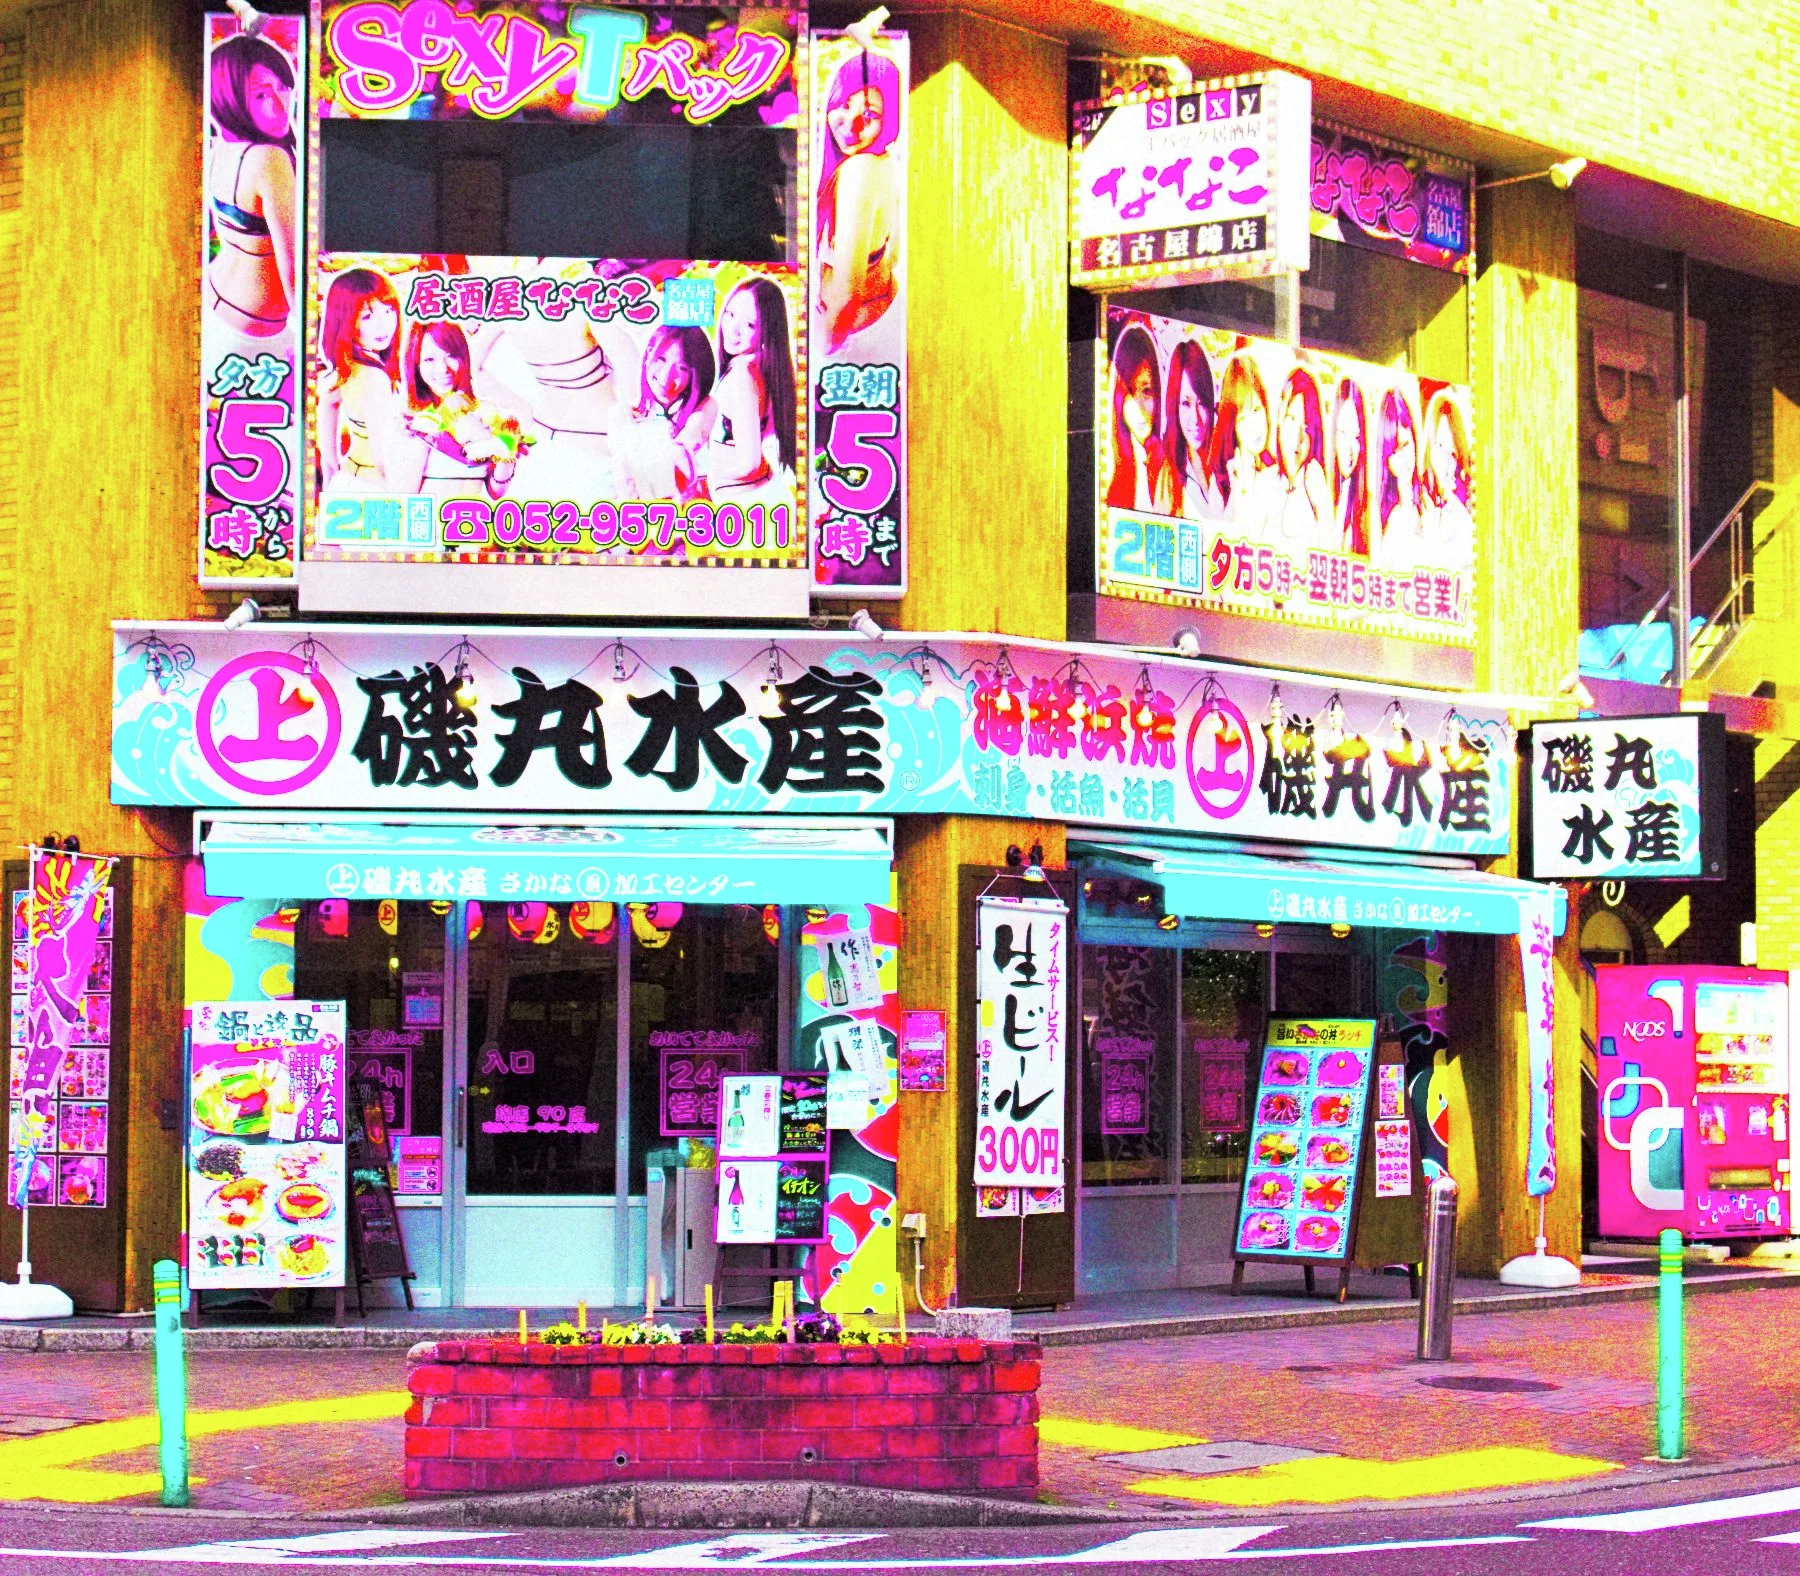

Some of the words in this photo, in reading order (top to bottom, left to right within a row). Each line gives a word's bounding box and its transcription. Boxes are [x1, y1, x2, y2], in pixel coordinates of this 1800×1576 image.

[333, 0, 577, 117] Sexy
[1149, 89, 1261, 128] Sexy
[1092, 147, 1268, 219] ななこ
[1097, 219, 1259, 266] 名古屋錦店
[411, 276, 657, 323] 居酒屋ななこ
[212, 355, 288, 395] 夕方
[822, 366, 898, 406] 翌朝
[210, 402, 288, 503] 5
[820, 412, 897, 513] 5
[325, 500, 402, 541] 2階
[411, 502, 430, 541] 西側
[494, 501, 790, 547] 052-957-3011
[1113, 519, 1175, 580] 2階
[1181, 526, 1197, 586] 西側
[351, 662, 885, 794] 磯丸水産
[973, 669, 1176, 769] 海鮮浜焼
[1259, 713, 1491, 833] 磯丸水産
[1541, 732, 1658, 793] 磯丸
[1561, 801, 1681, 864] 水産
[362, 866, 488, 896] 磯丸水産
[1286, 893, 1349, 921] 磯丸水産
[993, 921, 1055, 1122] 生ビール
[482, 1049, 535, 1074] 入口
[980, 1060, 990, 1117] 磯丸水産
[319, 1053, 339, 1138] 豚キムチ鍋
[978, 1126, 1059, 1175] 300円
